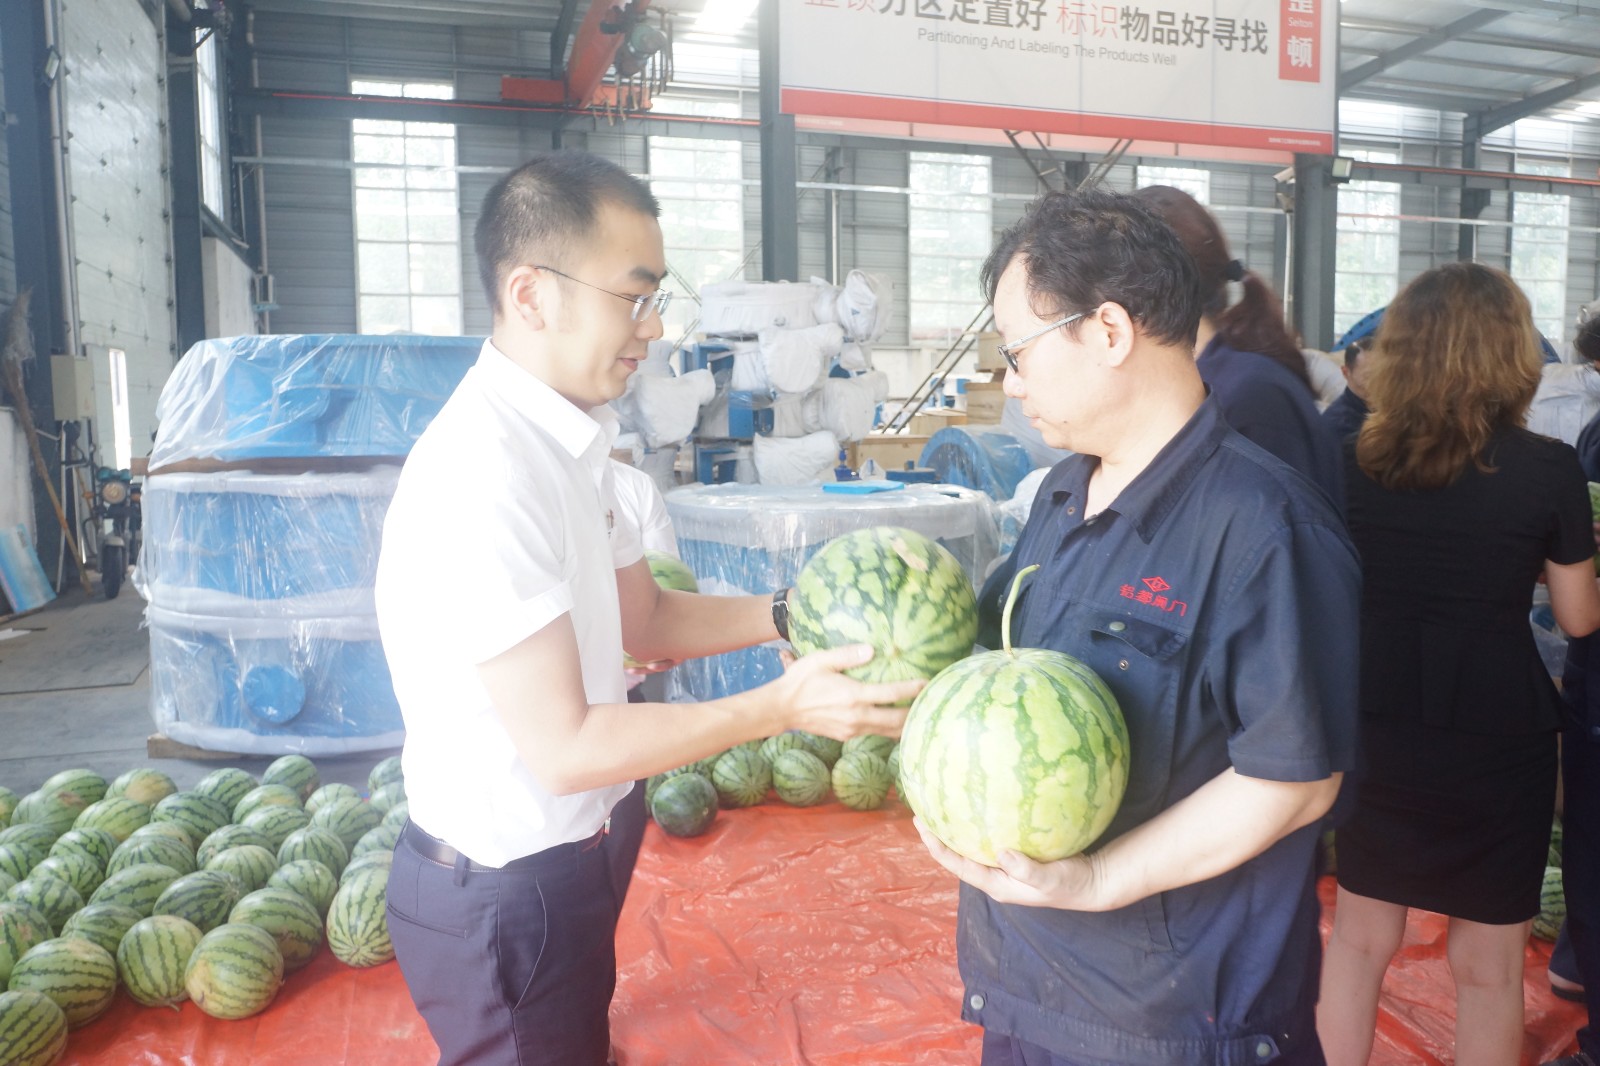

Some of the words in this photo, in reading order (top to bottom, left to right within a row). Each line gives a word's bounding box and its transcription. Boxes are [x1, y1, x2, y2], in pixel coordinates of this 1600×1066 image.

[917, 27, 989, 50] Partitioning
[990, 36, 1016, 50] And
[1019, 38, 1070, 59] Labeling
[1072, 44, 1096, 58] The
[1098, 47, 1150, 64] Products
[1152, 52, 1177, 66] Well
[1056, 0, 1268, 54] 标识物品好寻找
[1287, 35, 1313, 68] 顿
